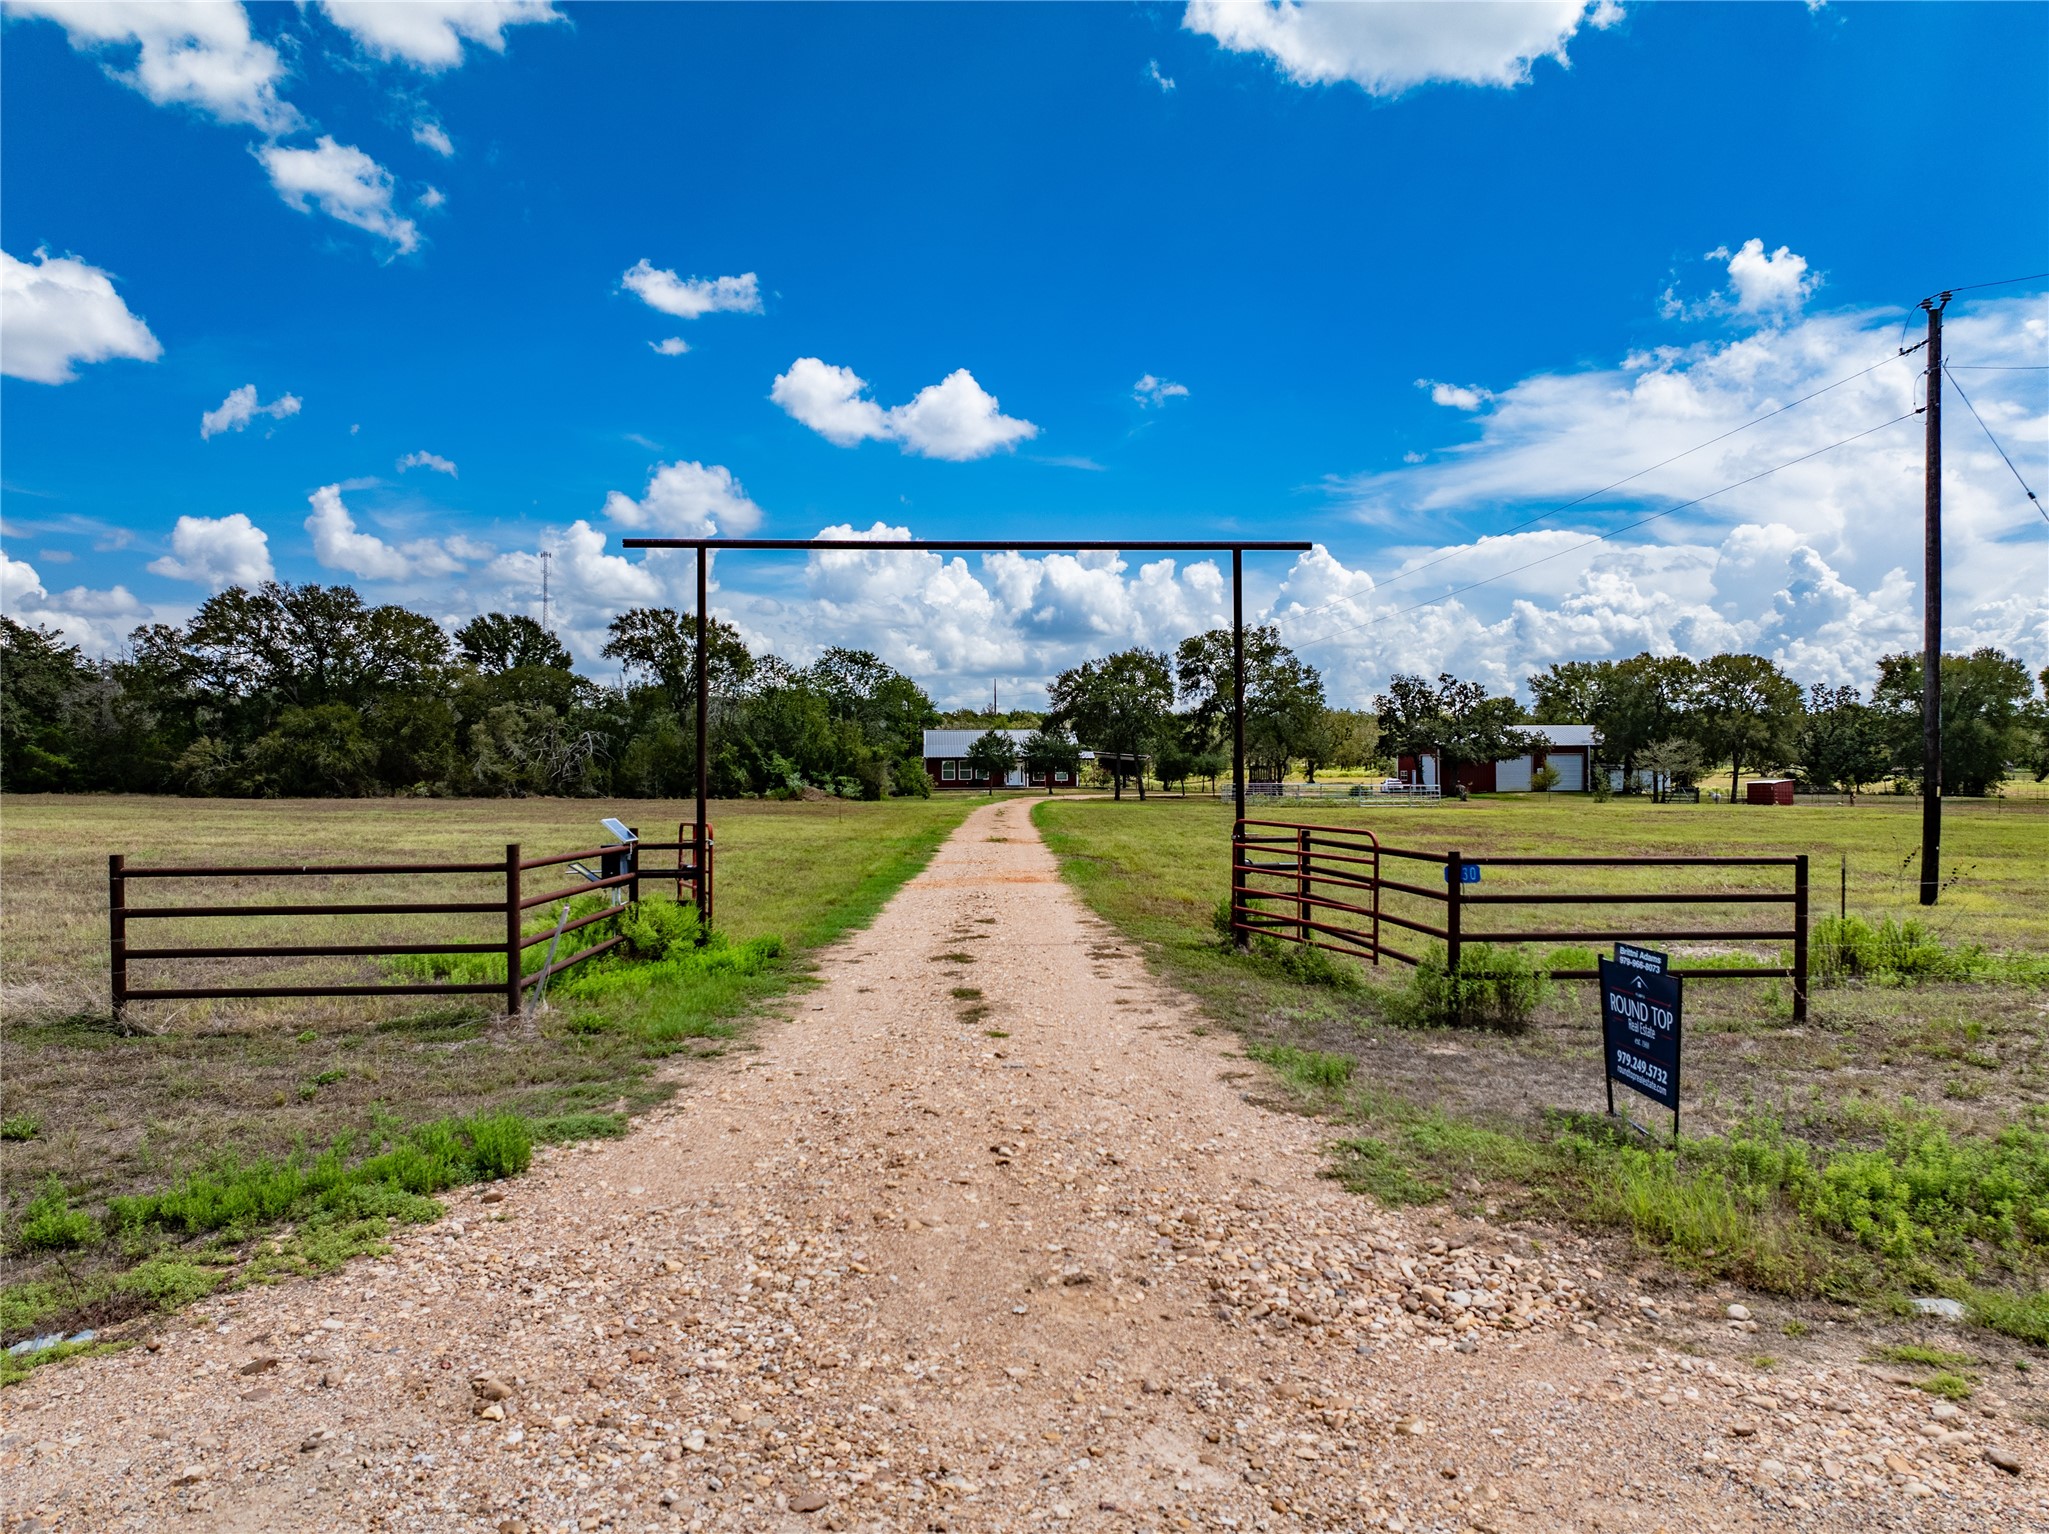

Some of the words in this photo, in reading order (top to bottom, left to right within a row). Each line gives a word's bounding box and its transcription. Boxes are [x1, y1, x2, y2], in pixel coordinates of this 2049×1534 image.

[1619, 946, 1639, 958] Brittni
[1639, 951, 1662, 964] Adams
[1609, 992, 1649, 1022] ROUND
[1650, 1005, 1673, 1031] TOP
[1627, 1017, 1640, 1033] Real
[1640, 1022, 1656, 1039] Estate
[1616, 1049, 1668, 1085] 979.249.5732
[1616, 1064, 1667, 1096] roundtoprealestate.com
